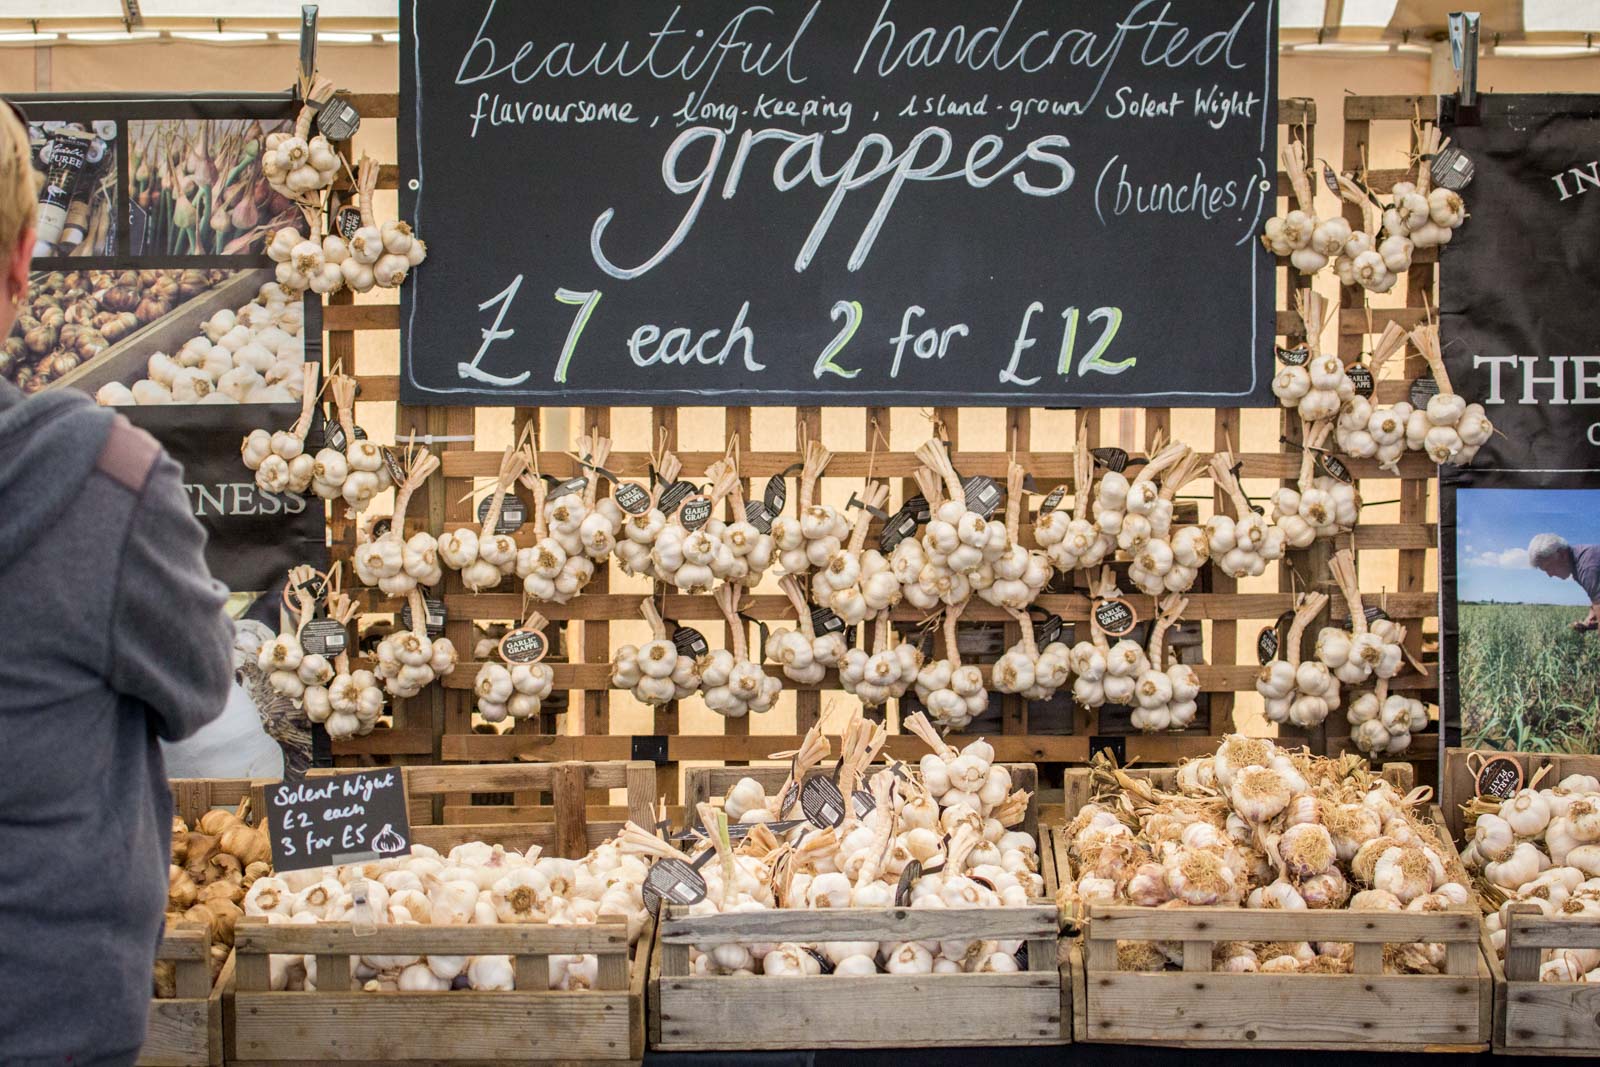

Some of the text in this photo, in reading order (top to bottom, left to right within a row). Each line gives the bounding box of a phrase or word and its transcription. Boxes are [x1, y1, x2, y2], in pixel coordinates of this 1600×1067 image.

[455, 0, 1256, 115] beautiful handcrafted
[1105, 86, 1185, 119] Solent
[1194, 84, 1261, 130] Wight
[590, 125, 1076, 280] grappes
[626, 301, 766, 372] each
[812, 299, 863, 379] 2
[888, 304, 970, 379] for
[998, 301, 1138, 386] £12
[1473, 355, 1600, 405] THE
[1098, 604, 1124, 620] GARLIC
[506, 635, 537, 649] GARLIC
[507, 641, 539, 654] GRAPPE
[1489, 768, 1508, 793] PLAIT
[273, 781, 340, 807] Solent
[322, 803, 365, 821] each
[280, 836, 297, 856] 3
[305, 829, 335, 855] for
